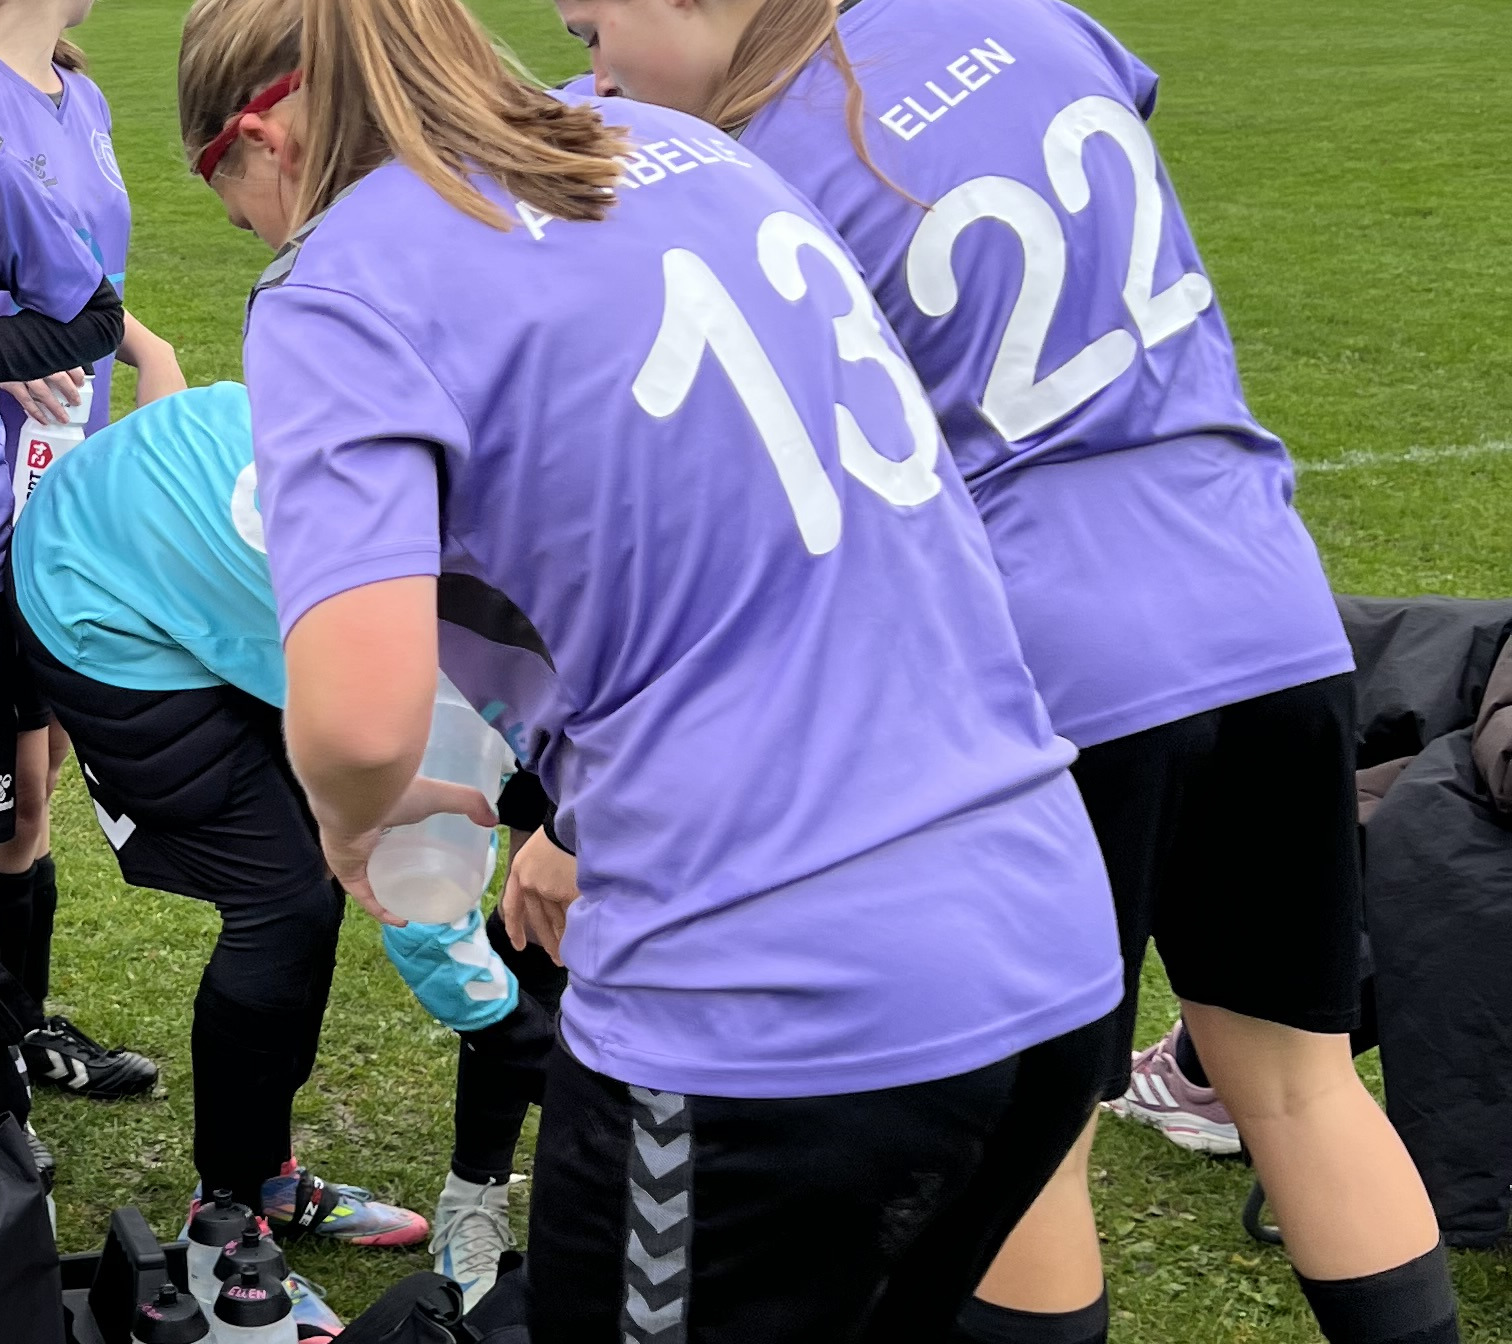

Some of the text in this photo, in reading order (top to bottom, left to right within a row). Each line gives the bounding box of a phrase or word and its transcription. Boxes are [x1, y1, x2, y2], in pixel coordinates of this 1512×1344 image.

[879, 37, 1016, 141] ELLEN
[632, 210, 941, 555] 13
[906, 94, 1212, 442] 22
